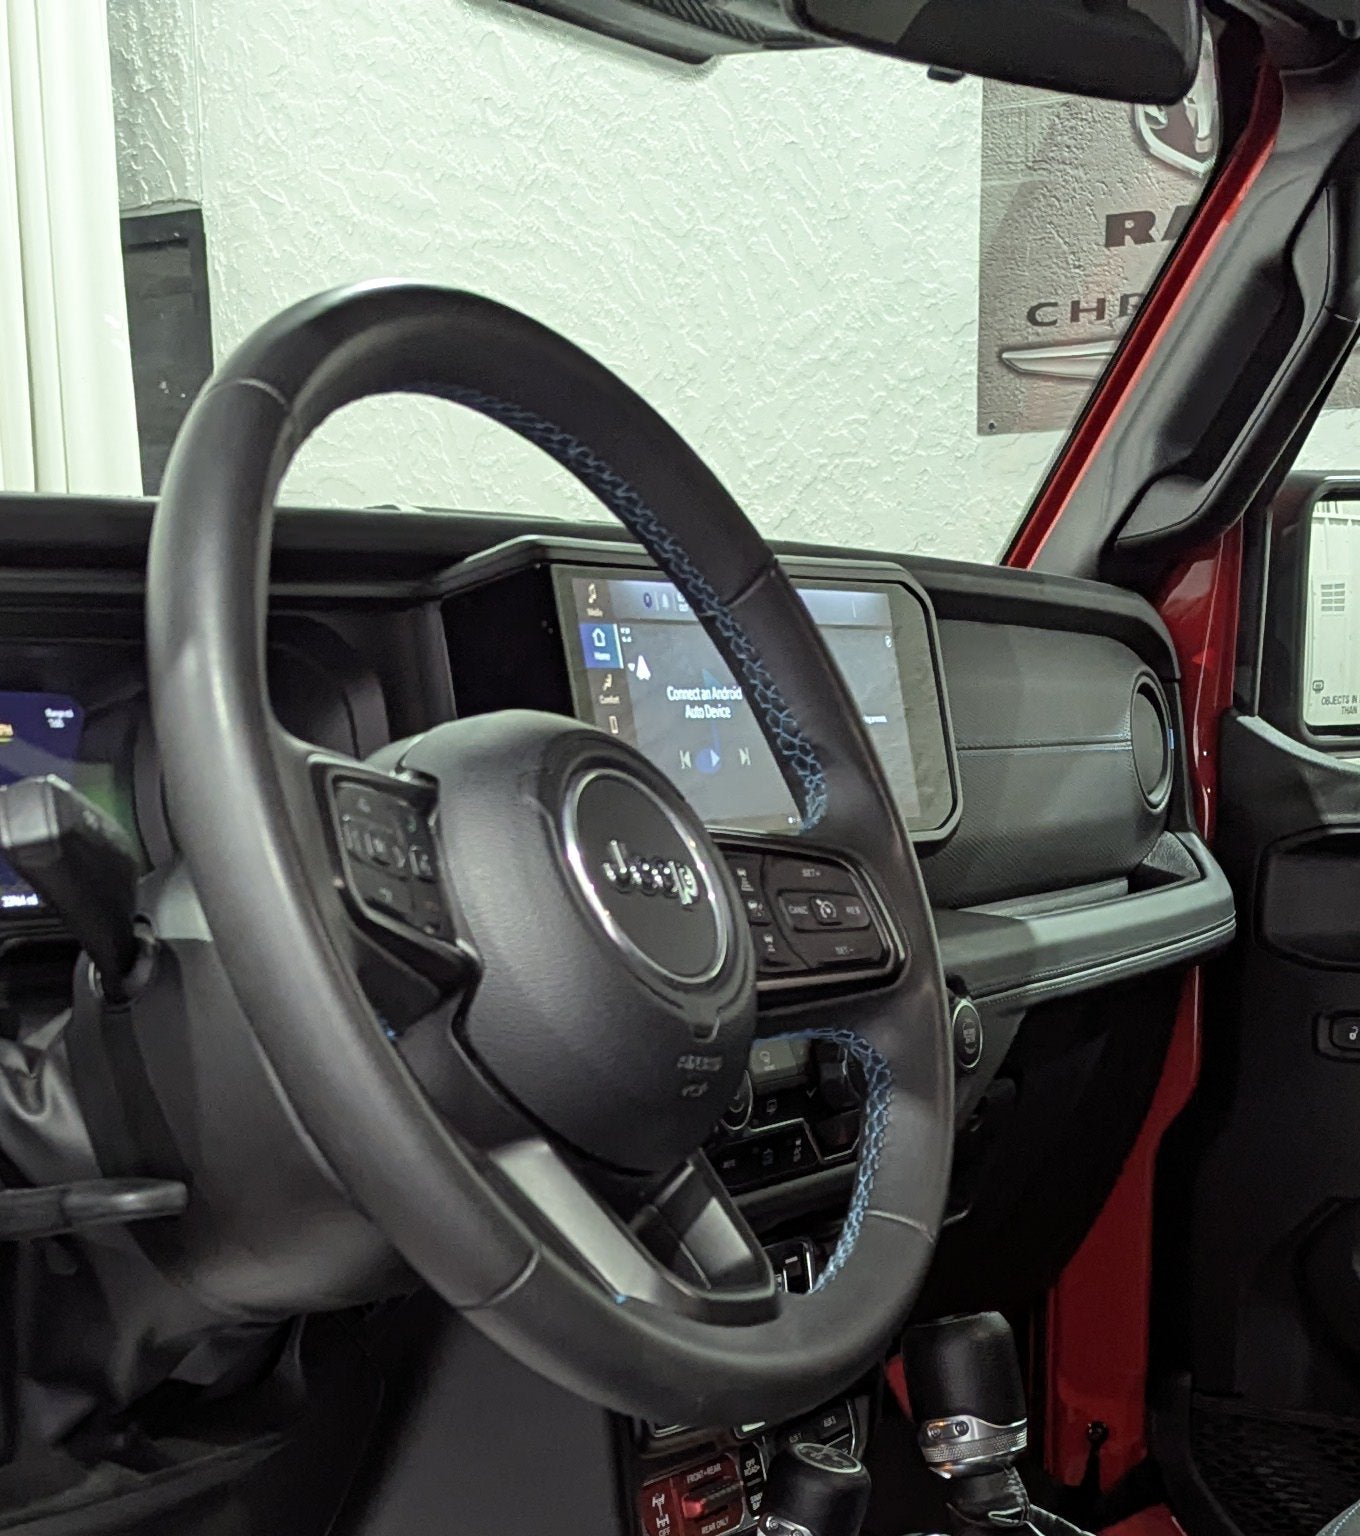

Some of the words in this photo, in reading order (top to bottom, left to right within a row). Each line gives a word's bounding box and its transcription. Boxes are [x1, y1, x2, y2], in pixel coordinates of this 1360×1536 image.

[666, 685, 701, 701] Connect
[701, 688, 712, 700] an
[712, 685, 743, 700] Android
[1321, 695, 1350, 705] OBJECTS
[1351, 695, 1358, 703] IN
[685, 704, 704, 718] Auto
[704, 704, 732, 718] Device
[1341, 705, 1358, 715] THAN
[602, 839, 699, 905] Jeep
